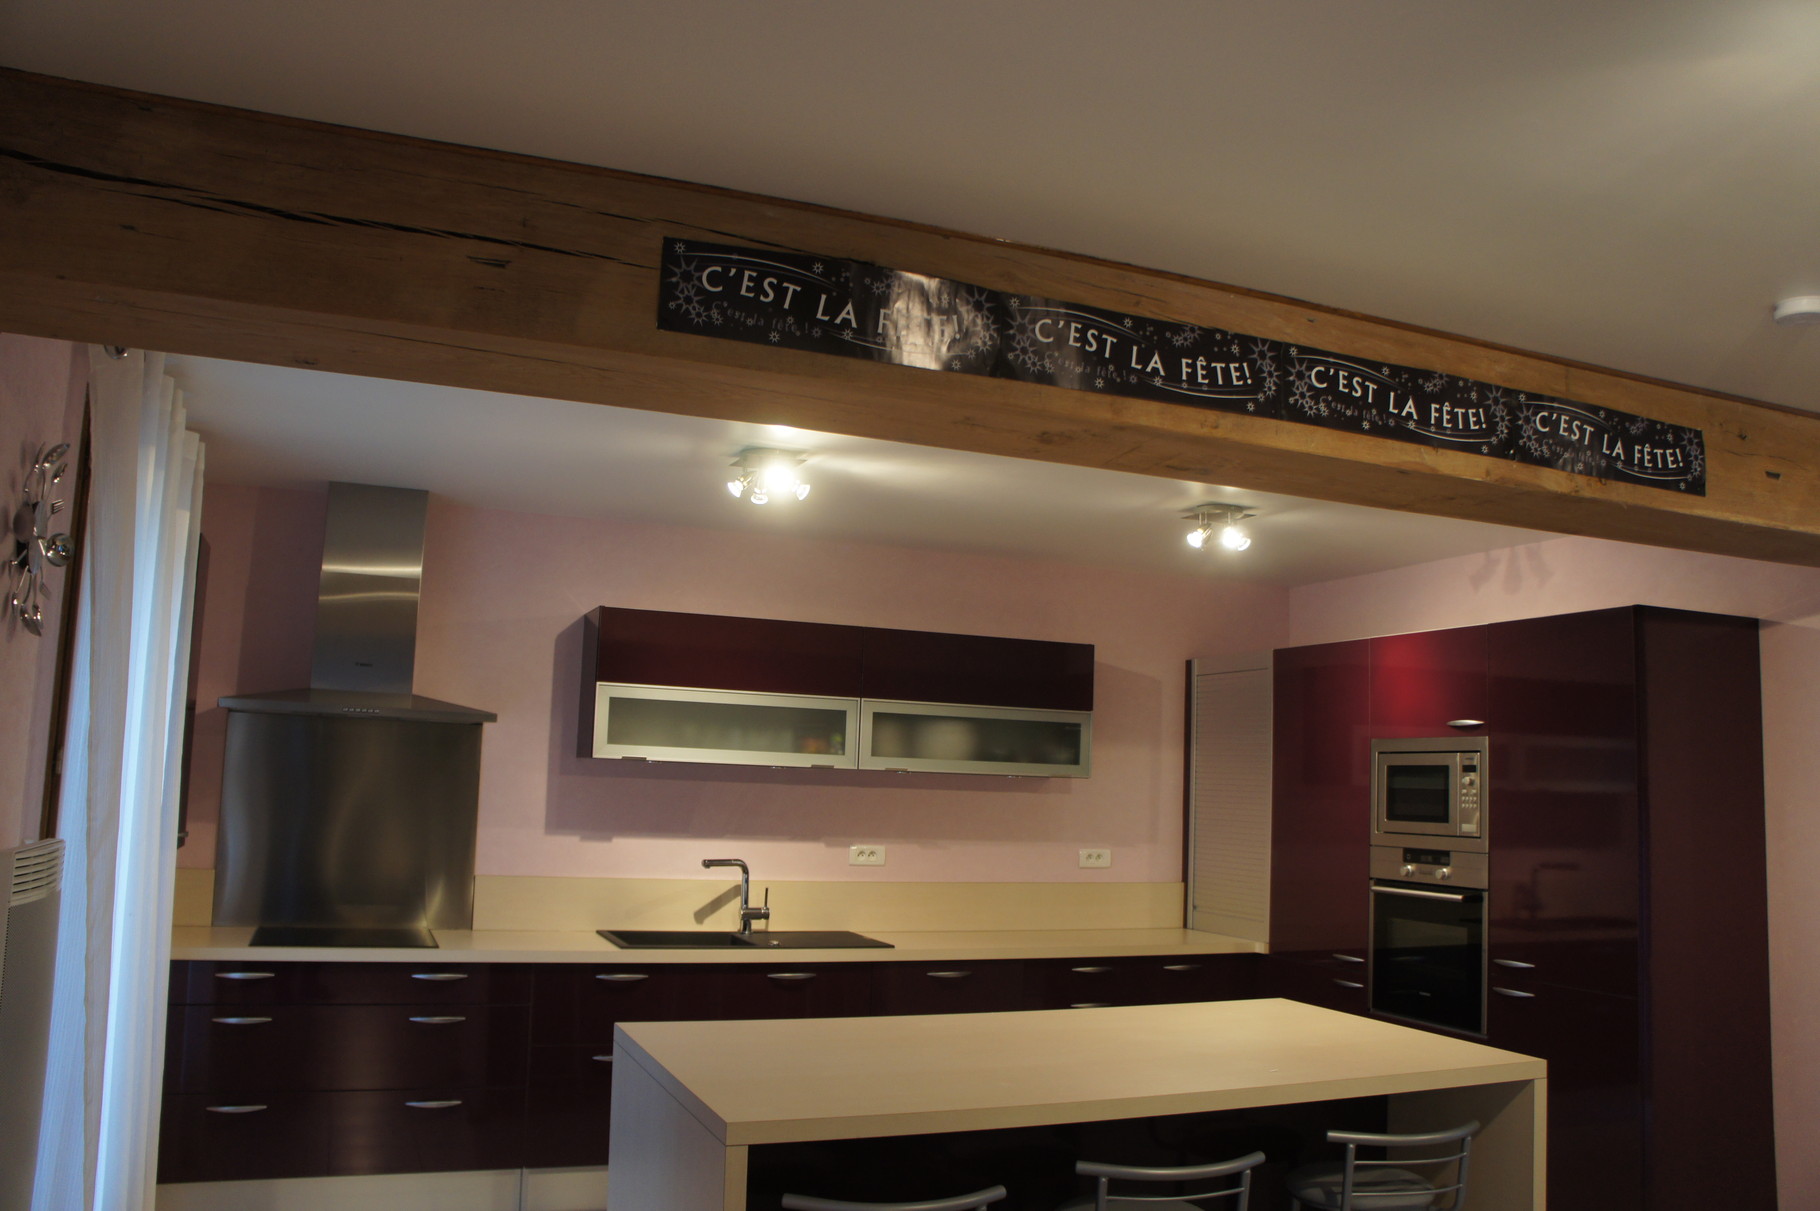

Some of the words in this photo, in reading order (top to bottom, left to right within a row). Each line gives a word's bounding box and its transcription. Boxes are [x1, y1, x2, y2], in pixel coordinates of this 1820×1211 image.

[701, 266, 801, 310] C'EST
[816, 293, 857, 328] LA
[1035, 318, 1117, 359] C'EST
[1131, 345, 1165, 376] LA
[1181, 356, 1252, 386] FÊTE!
[1311, 366, 1377, 404] C'EST
[1389, 391, 1418, 420] LA
[1430, 402, 1487, 430] FÊTE!
[1535, 411, 1594, 446] C'EST
[1602, 433, 1624, 461] LA
[1634, 443, 1683, 469] FÊTE!
